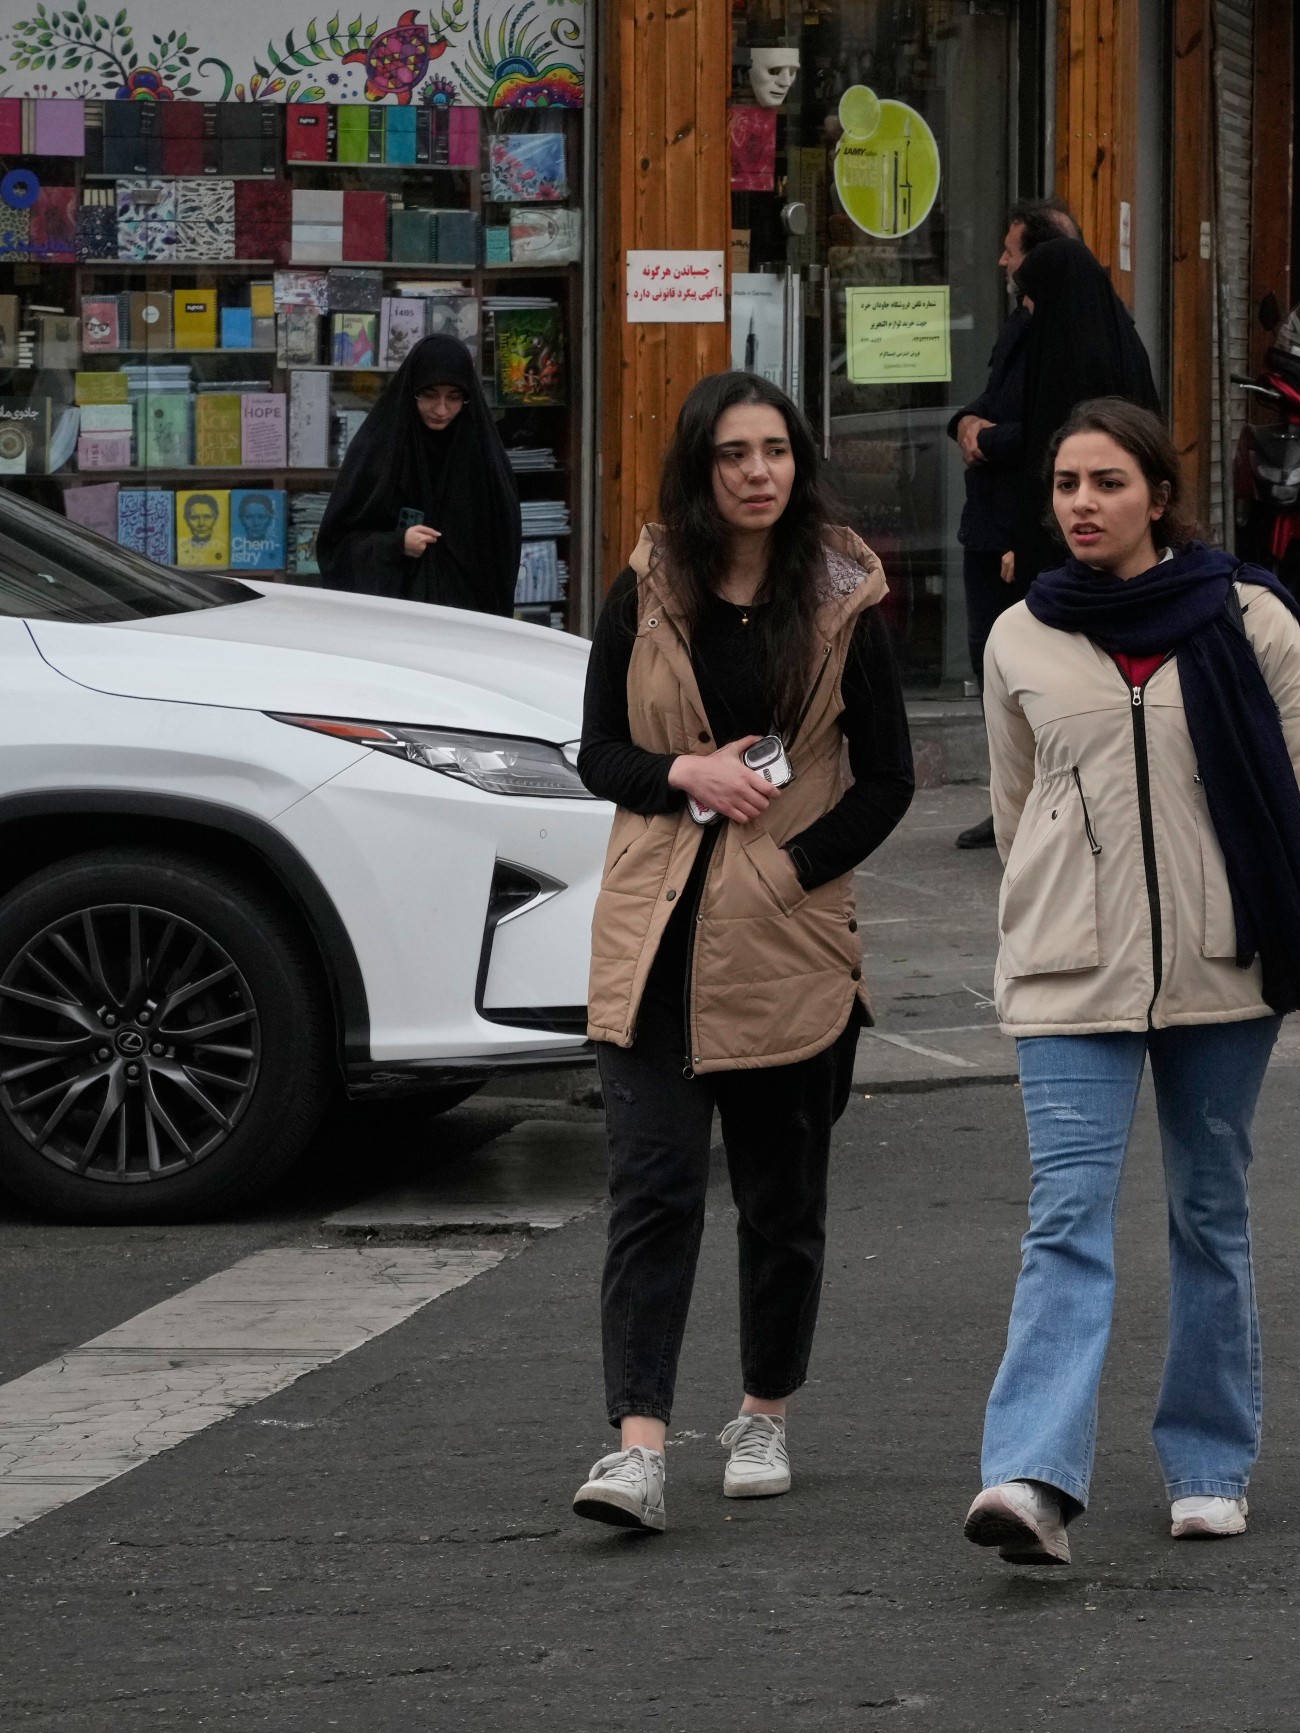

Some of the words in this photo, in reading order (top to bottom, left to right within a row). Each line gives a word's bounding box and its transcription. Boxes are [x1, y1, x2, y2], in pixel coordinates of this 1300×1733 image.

[844, 147, 866, 156] LAMY
[673, 265, 710, 280] چسباندن
[633, 288, 651, 301] دارد
[652, 287, 676, 301] قانونی
[677, 288, 697, 301] پیگرد
[698, 287, 719, 301] آگهی
[244, 407, 282, 418] HOPE
[231, 537, 280, 550] Chem-
